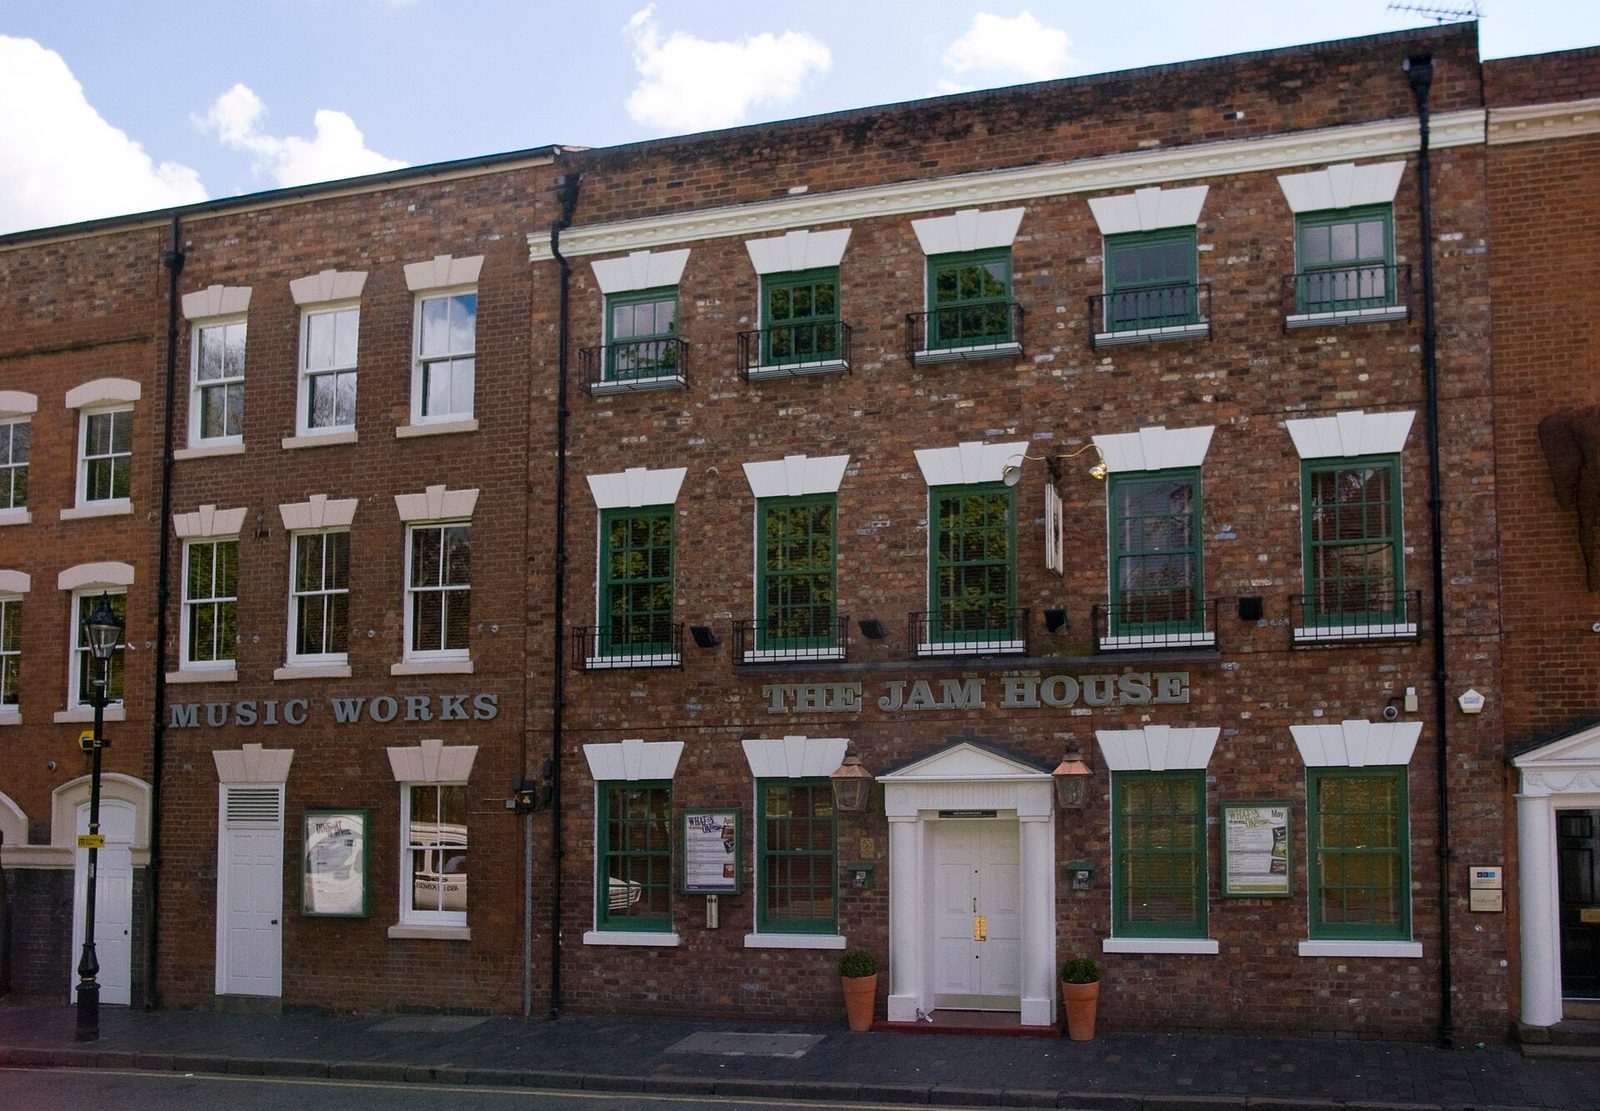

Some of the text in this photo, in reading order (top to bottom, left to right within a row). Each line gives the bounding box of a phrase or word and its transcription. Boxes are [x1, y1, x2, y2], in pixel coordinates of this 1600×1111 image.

[762, 671, 1191, 714] THE JAM HOUSE
[168, 693, 499, 728] MUSIC WORKS
[1271, 810, 1284, 819] May
